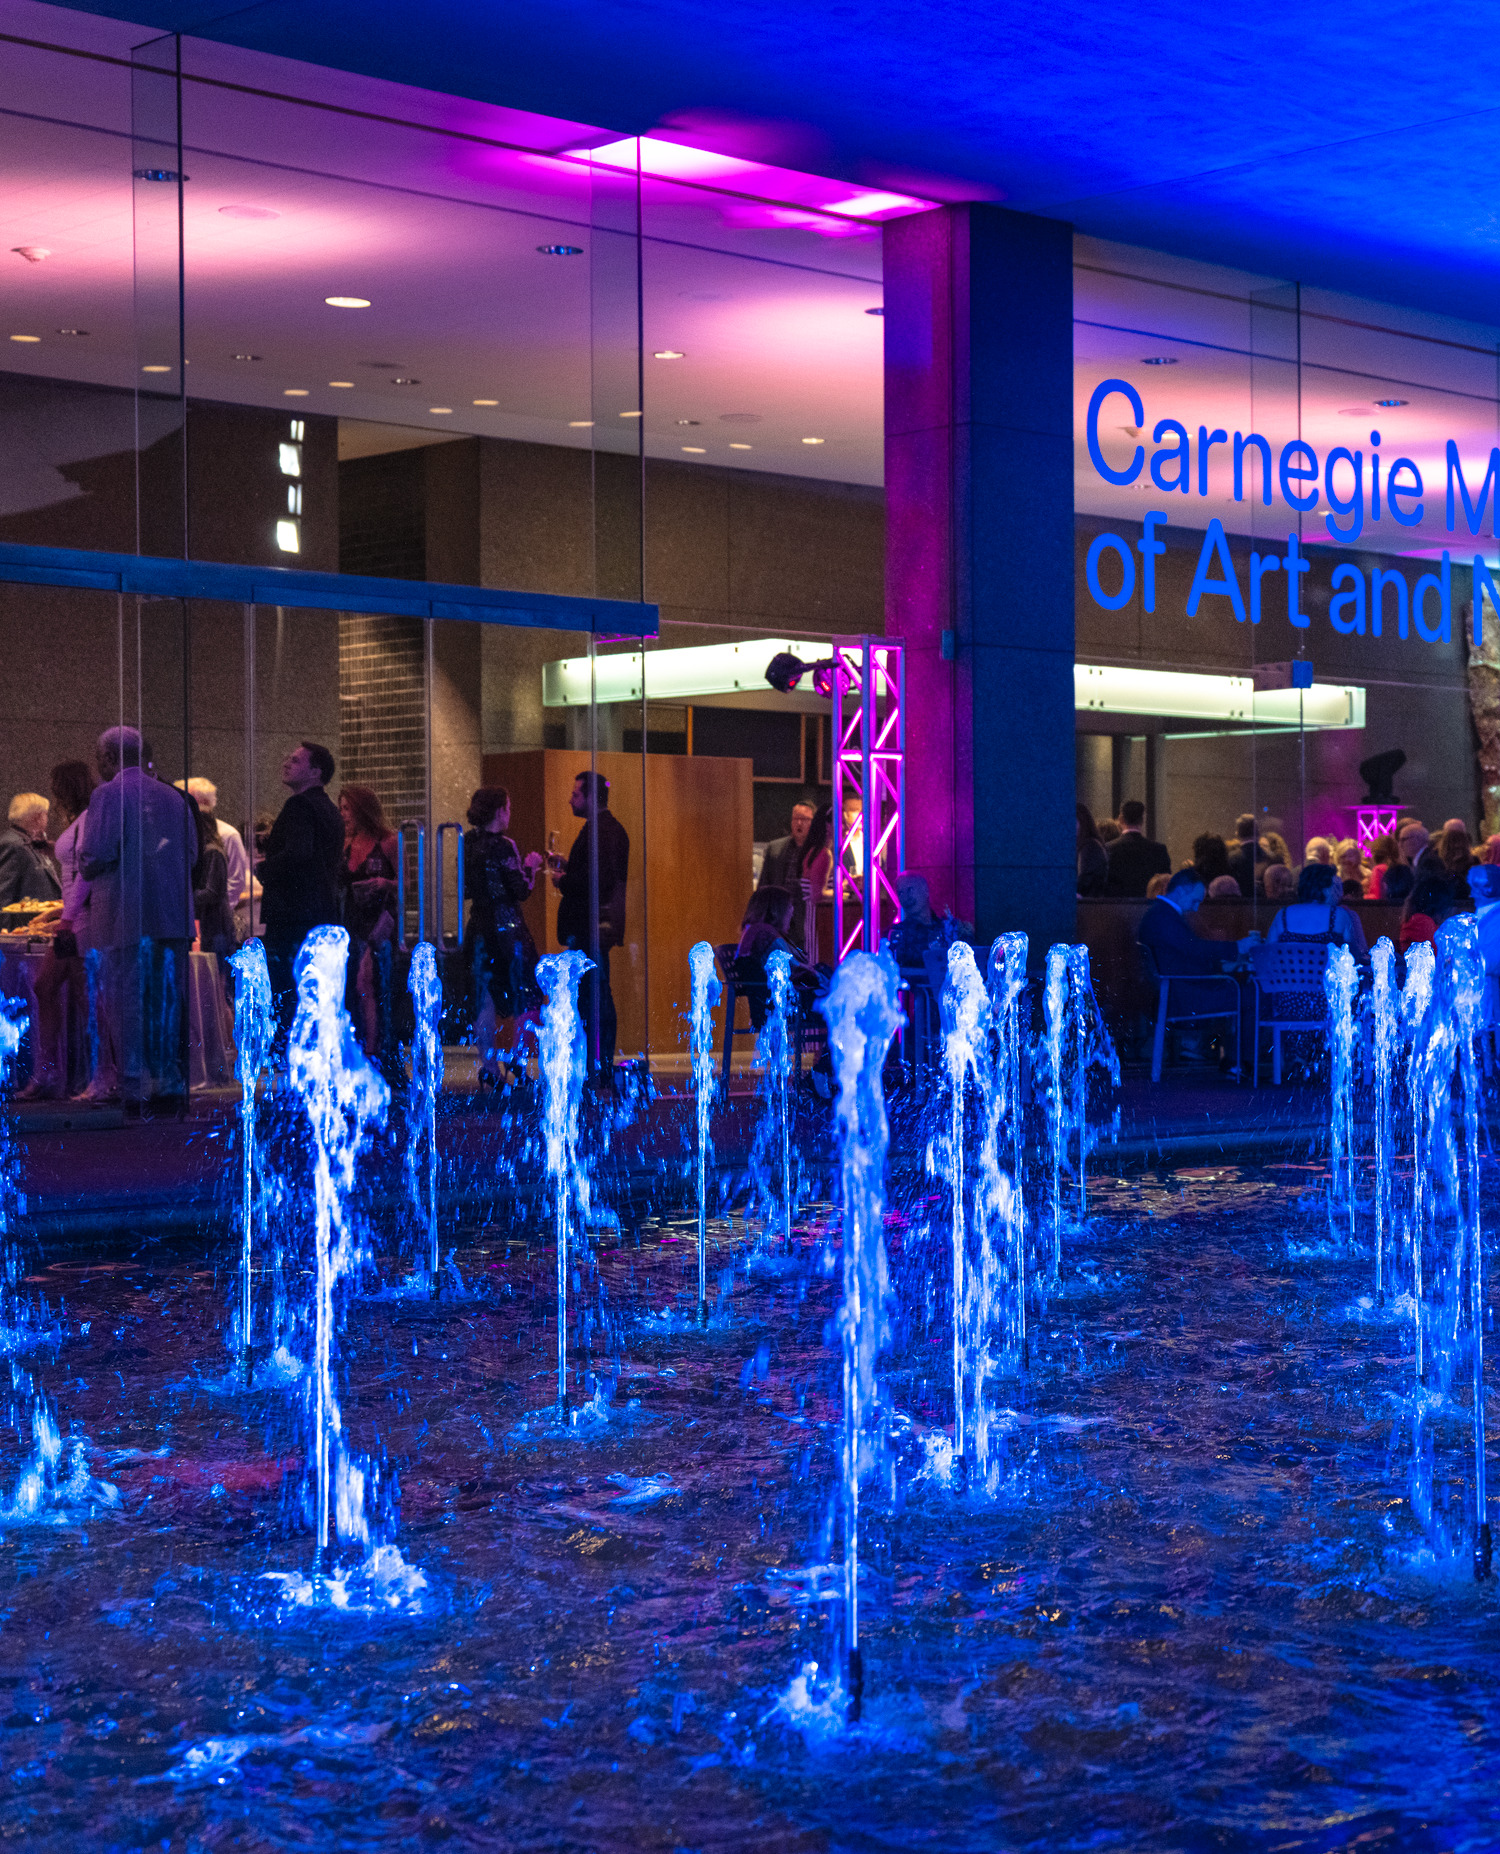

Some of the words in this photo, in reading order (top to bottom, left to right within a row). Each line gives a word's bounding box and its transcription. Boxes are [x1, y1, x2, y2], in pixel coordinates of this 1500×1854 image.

[1086, 378, 1424, 544] Carnegie
[1086, 510, 1168, 613] of
[1186, 517, 1311, 628] Art
[1329, 550, 1451, 644] and
